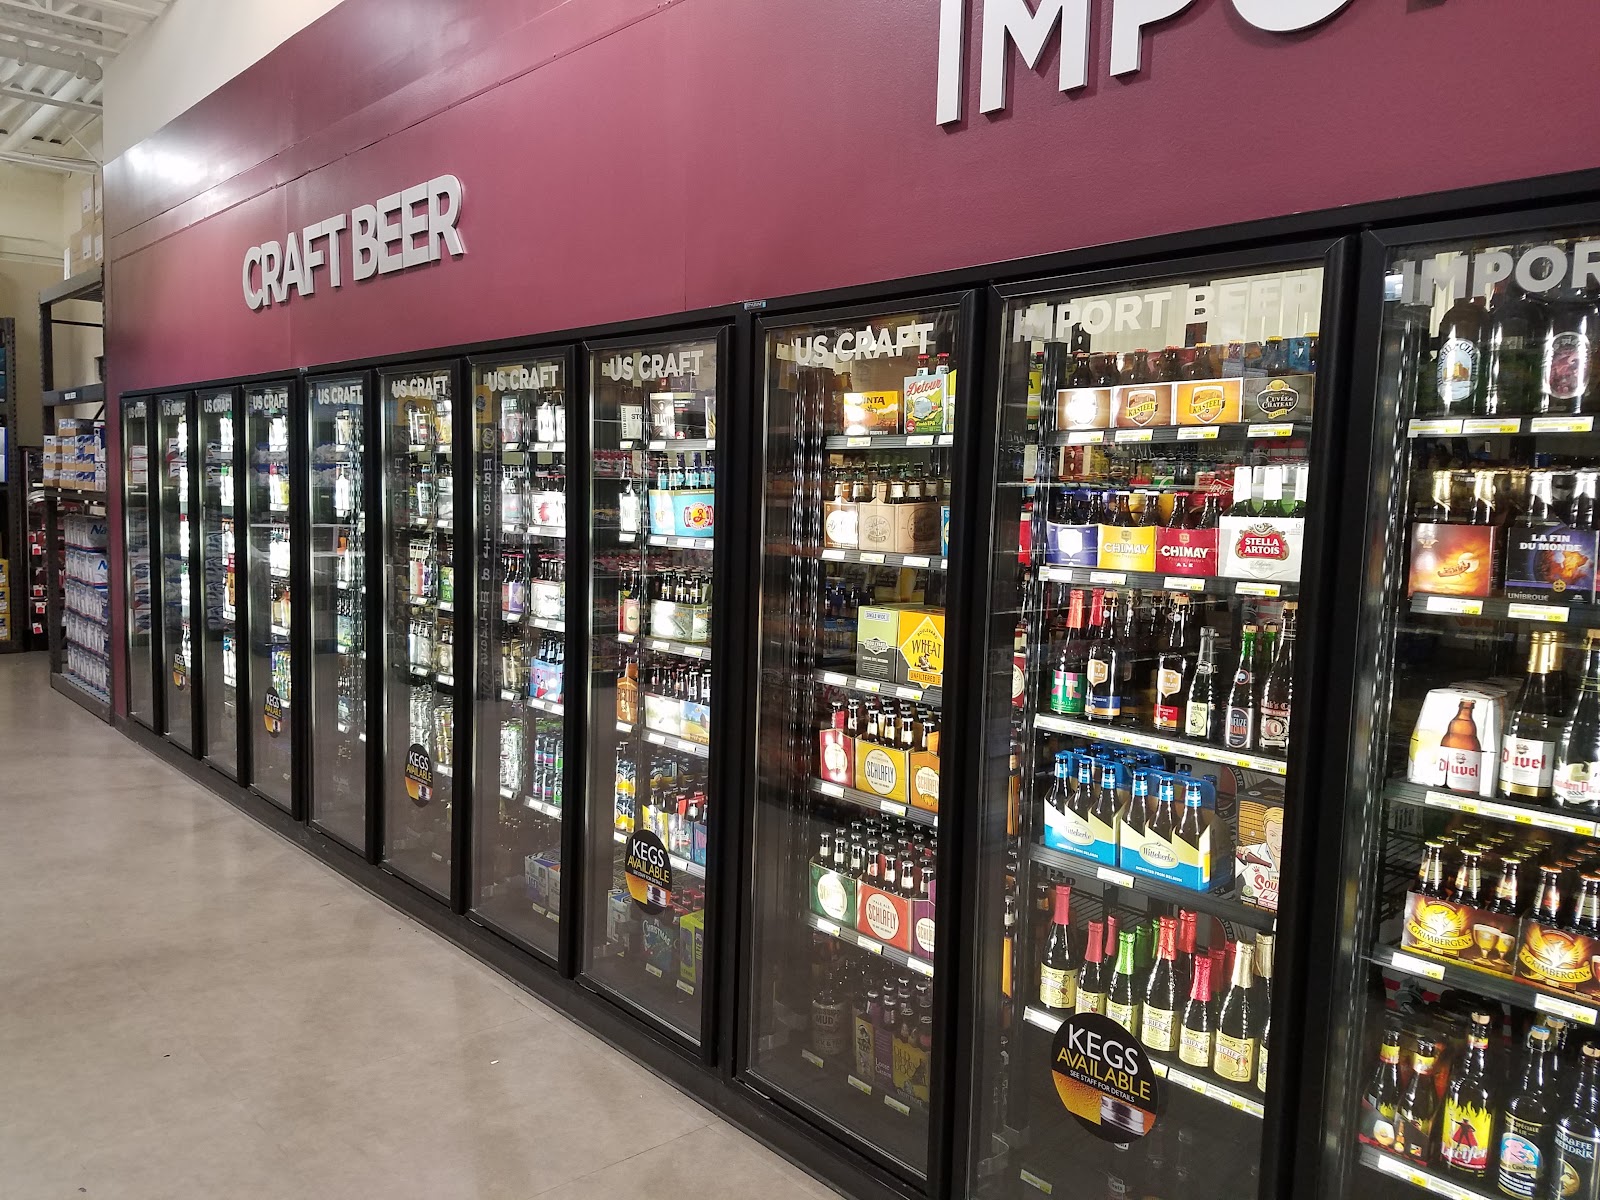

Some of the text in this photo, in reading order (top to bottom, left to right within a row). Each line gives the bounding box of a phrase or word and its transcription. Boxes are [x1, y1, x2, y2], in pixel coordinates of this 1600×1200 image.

[936, 0, 1327, 126] IMP
[242, 174, 464, 310] CRAFT BEER
[1013, 291, 1172, 343] IMPORT
[795, 322, 934, 366] US CRAFT
[610, 350, 704, 382] US CRAFT
[393, 376, 448, 398] US CRAFT
[488, 365, 559, 392] US CRAFT
[906, 379, 943, 396] Detour
[253, 395, 263, 410] US
[318, 385, 364, 405] US CRAFT
[204, 400, 212, 413] US
[1127, 401, 1155, 417] KASTEEL
[1191, 399, 1221, 414] KASTEEL
[1104, 542, 1149, 554] CHIMAY
[1245, 537, 1279, 547] STELLA
[1519, 542, 1582, 552] DU MONDE
[1531, 534, 1571, 542] LA FIN
[1160, 545, 1209, 559] CHIMAY
[1244, 546, 1280, 555] ARTOIS
[911, 639, 942, 659] WHEAT
[910, 670, 936, 683] UNFILTERED
[266, 693, 280, 709] KEGS
[409, 750, 429, 771] KEGS
[405, 764, 432, 783] AVAILABLE
[866, 762, 895, 784] SCHLAFLY
[632, 838, 665, 868] KEGS
[1143, 847, 1175, 863] Wittekerke
[627, 855, 670, 884] AVAILABLE
[1135, 865, 1183, 882] IMPORTED FROM BELGIUM
[1254, 873, 1279, 891] SOU
[867, 907, 897, 930] SCHLAFLY
[1410, 924, 1469, 947] GRIMBERGEN
[1524, 954, 1588, 980] GRIMBERGEN
[816, 1015, 835, 1025] MUD
[1068, 1023, 1139, 1076] KEGS
[1056, 1046, 1151, 1101] AVAILABLE
[1069, 1069, 1135, 1103] SEE STAFF FOR DETAILS
[1555, 1136, 1594, 1160] HENDRIK
[1556, 1130, 1593, 1151] STRAFFE
